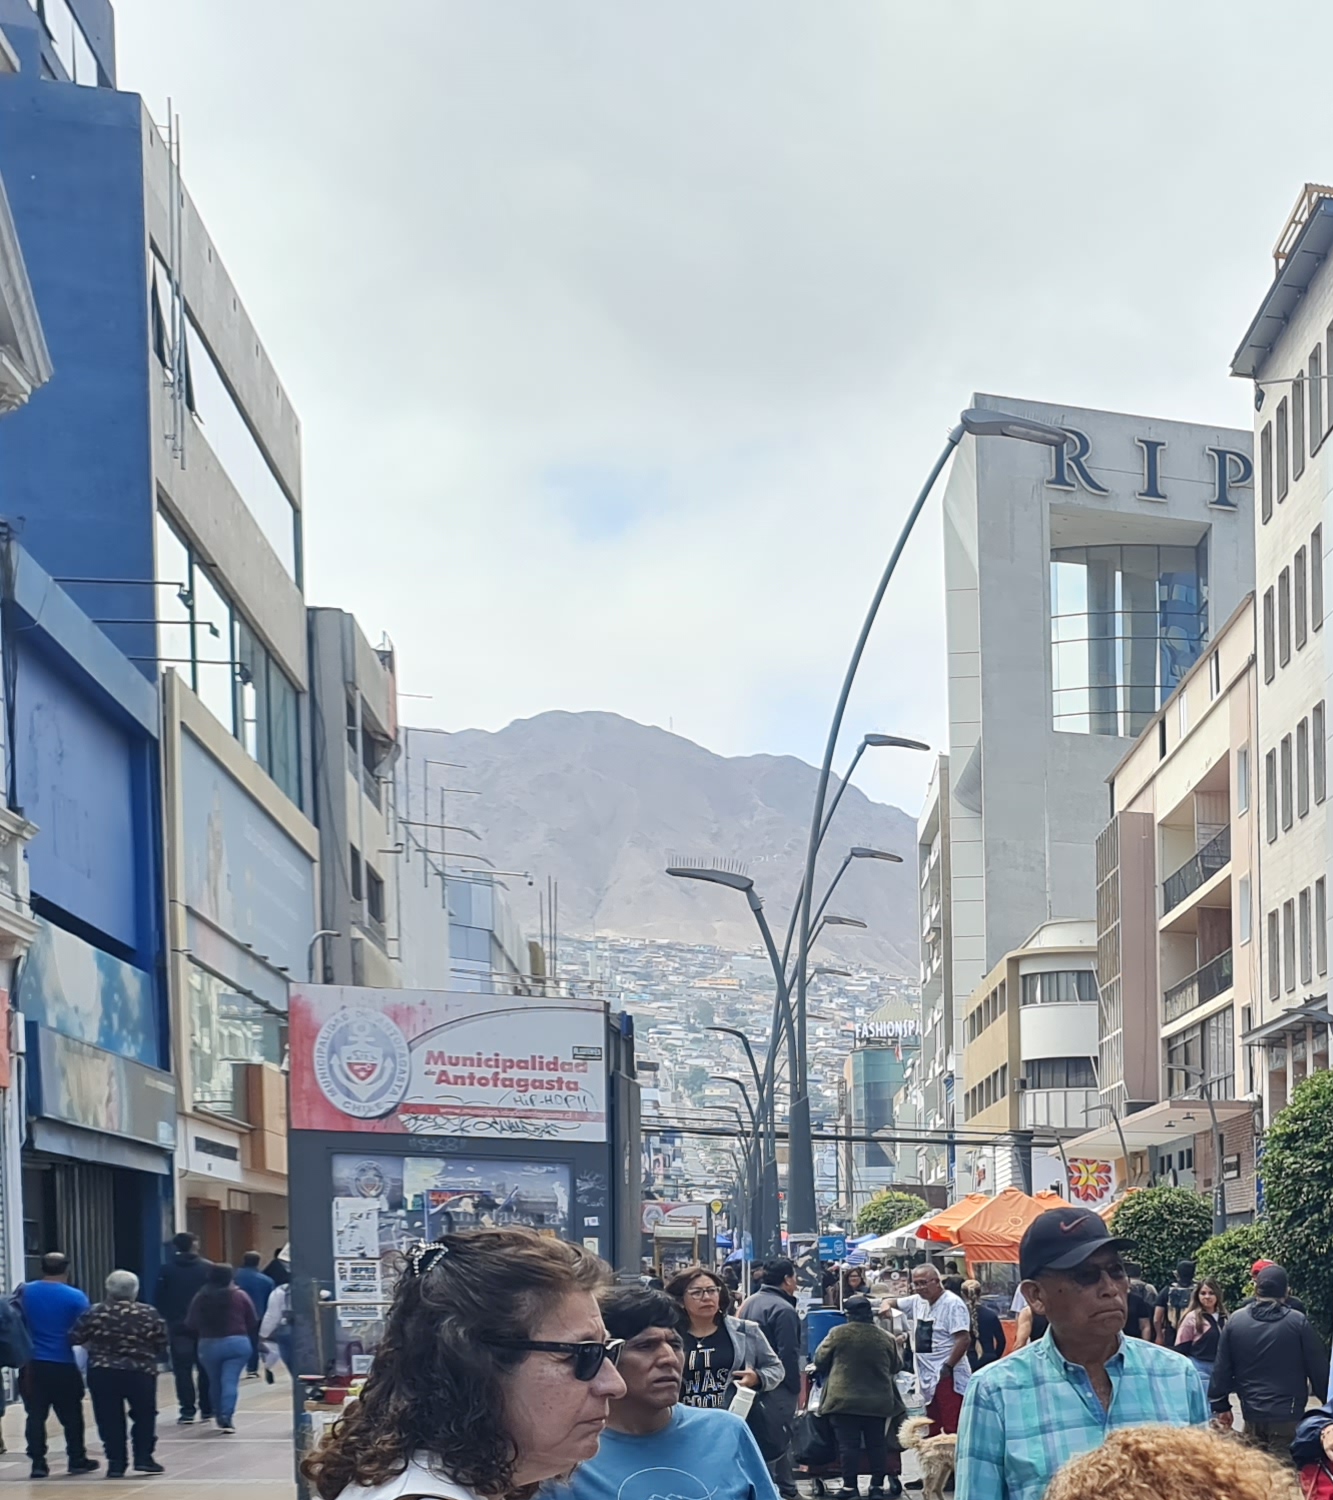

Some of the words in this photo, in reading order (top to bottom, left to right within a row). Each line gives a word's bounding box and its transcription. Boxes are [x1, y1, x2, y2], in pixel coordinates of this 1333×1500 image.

[424, 1050, 588, 1073] Municipalidad
[435, 1070, 579, 1093] Antofagasta
[689, 1348, 716, 1370] IT
[684, 1368, 729, 1394] WAS
